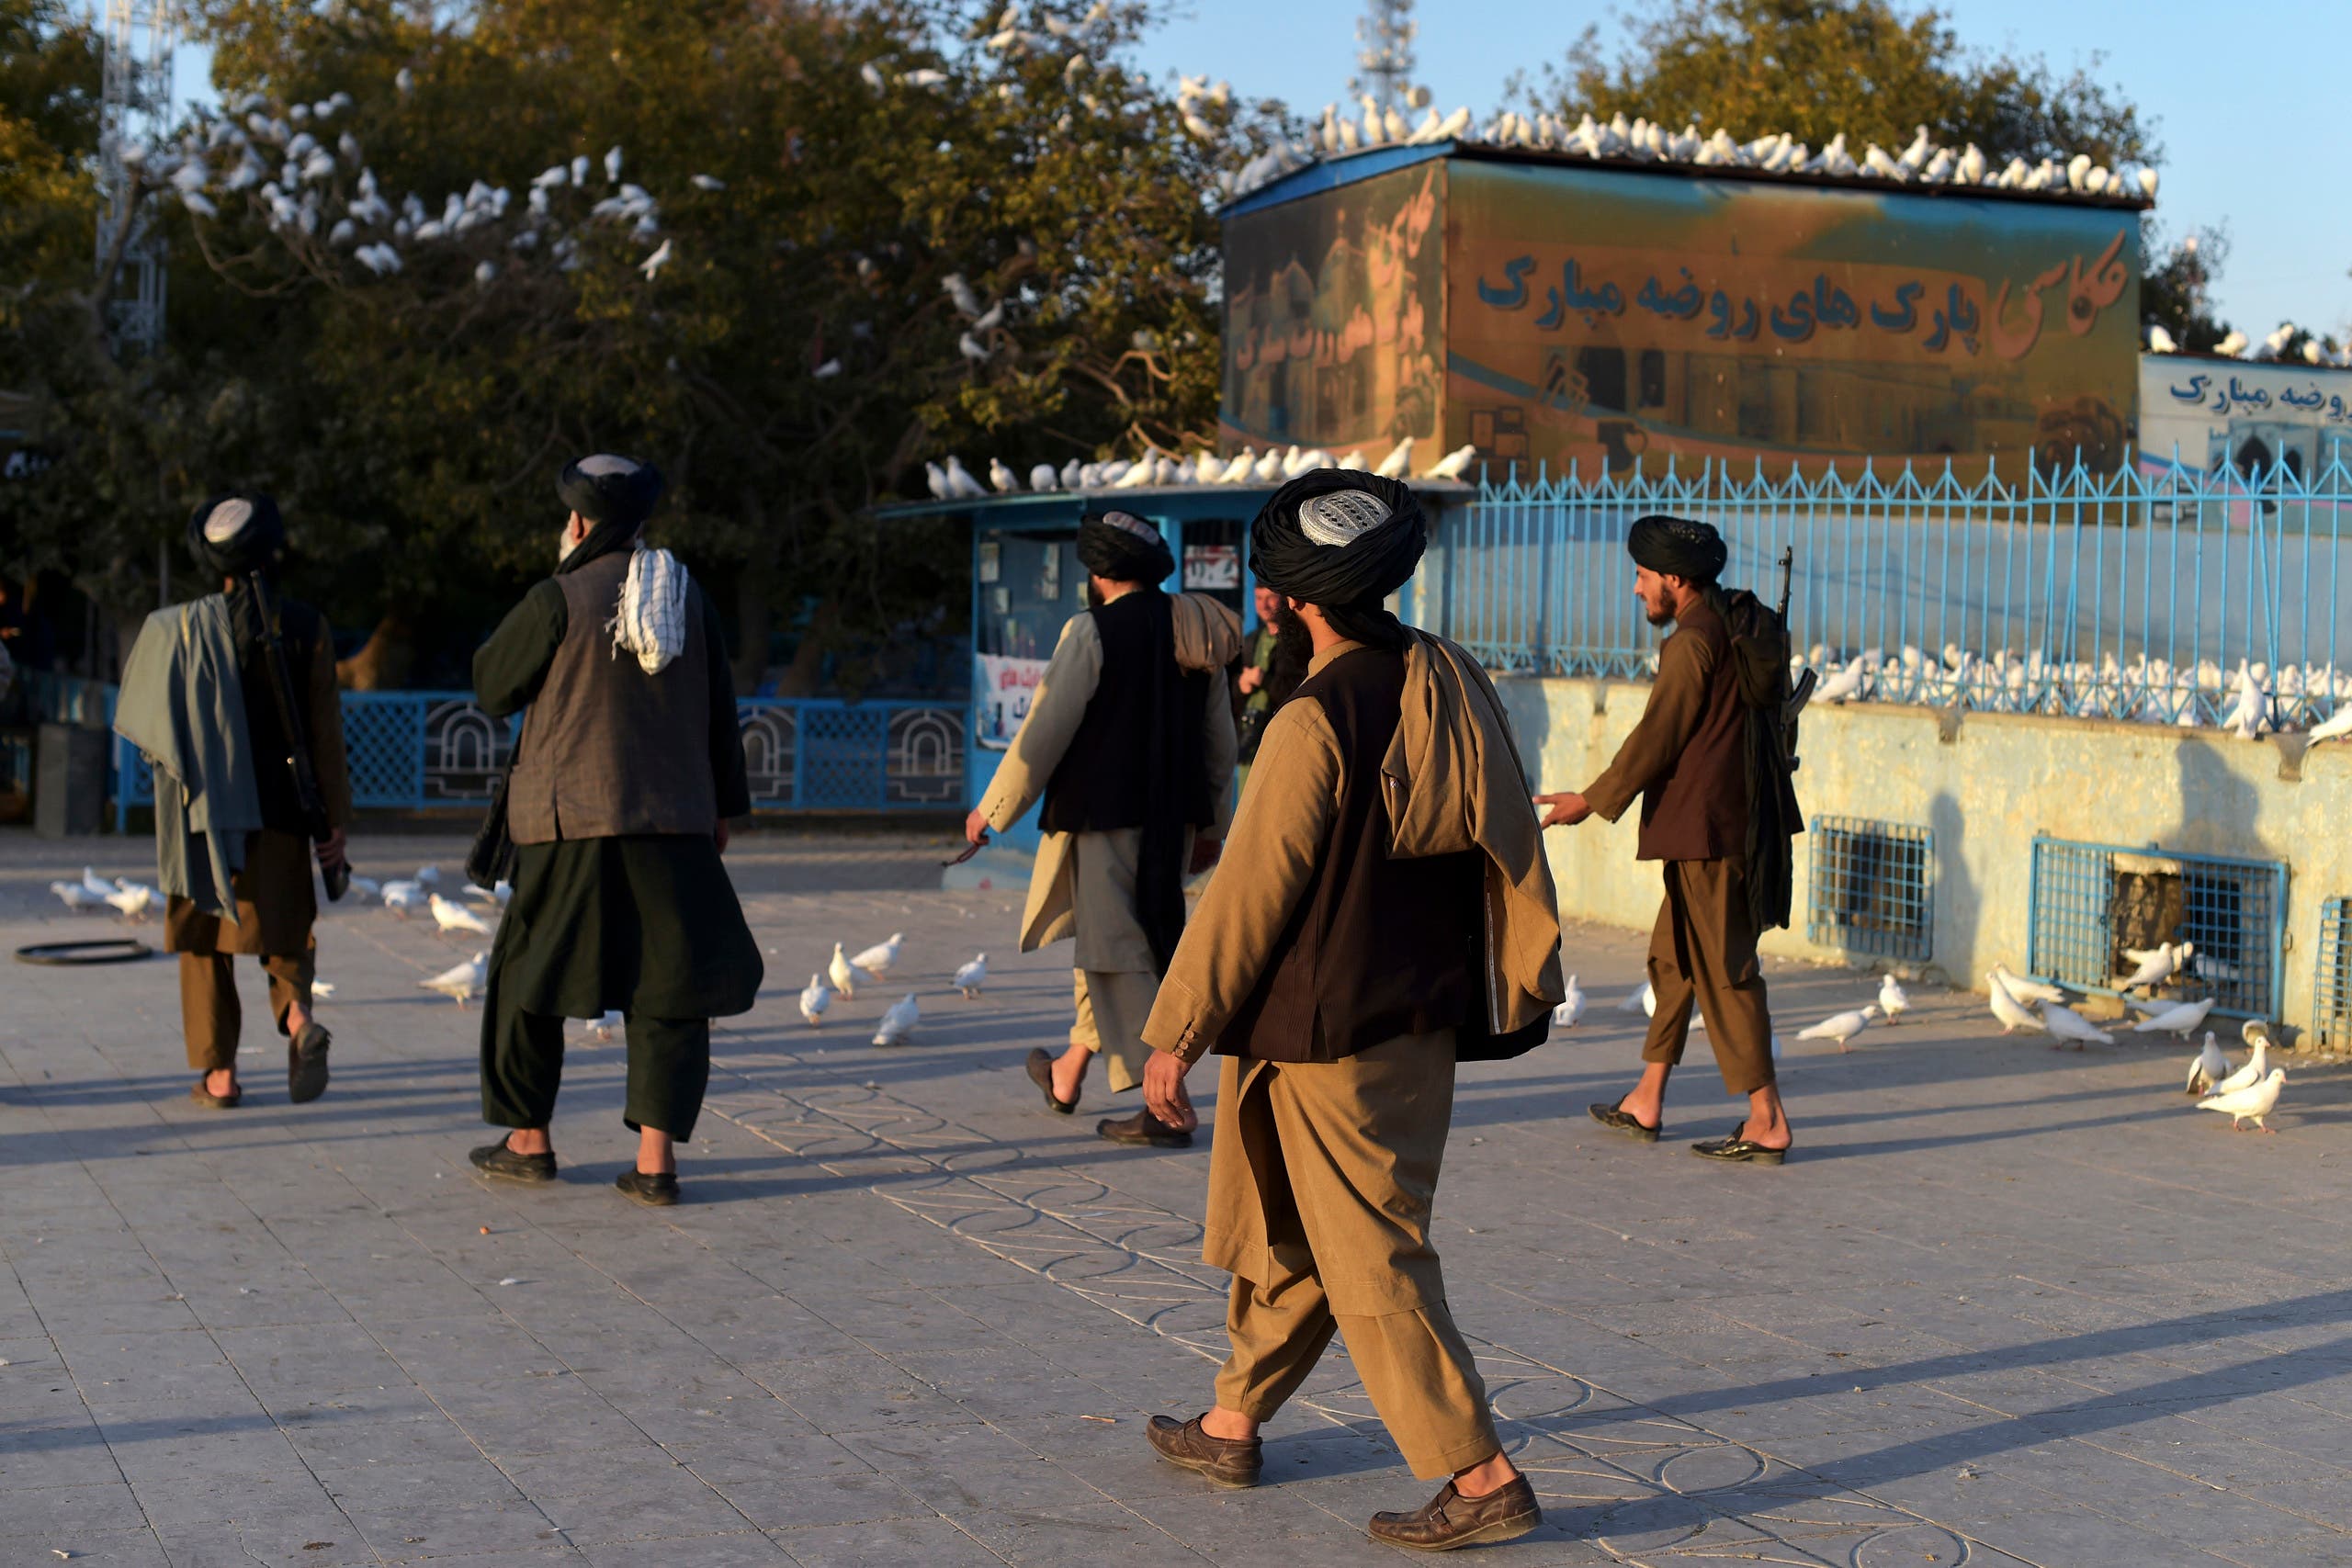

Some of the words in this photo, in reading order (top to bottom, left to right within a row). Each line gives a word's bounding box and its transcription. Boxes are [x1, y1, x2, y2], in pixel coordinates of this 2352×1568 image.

[1477, 254, 1625, 331] مبارک
[1637, 265, 1758, 343] روضه
[1770, 273, 1860, 343] های
[1871, 280, 1981, 356] پارک
[1990, 227, 2127, 361] عکاسی
[2170, 374, 2272, 415] مبارک
